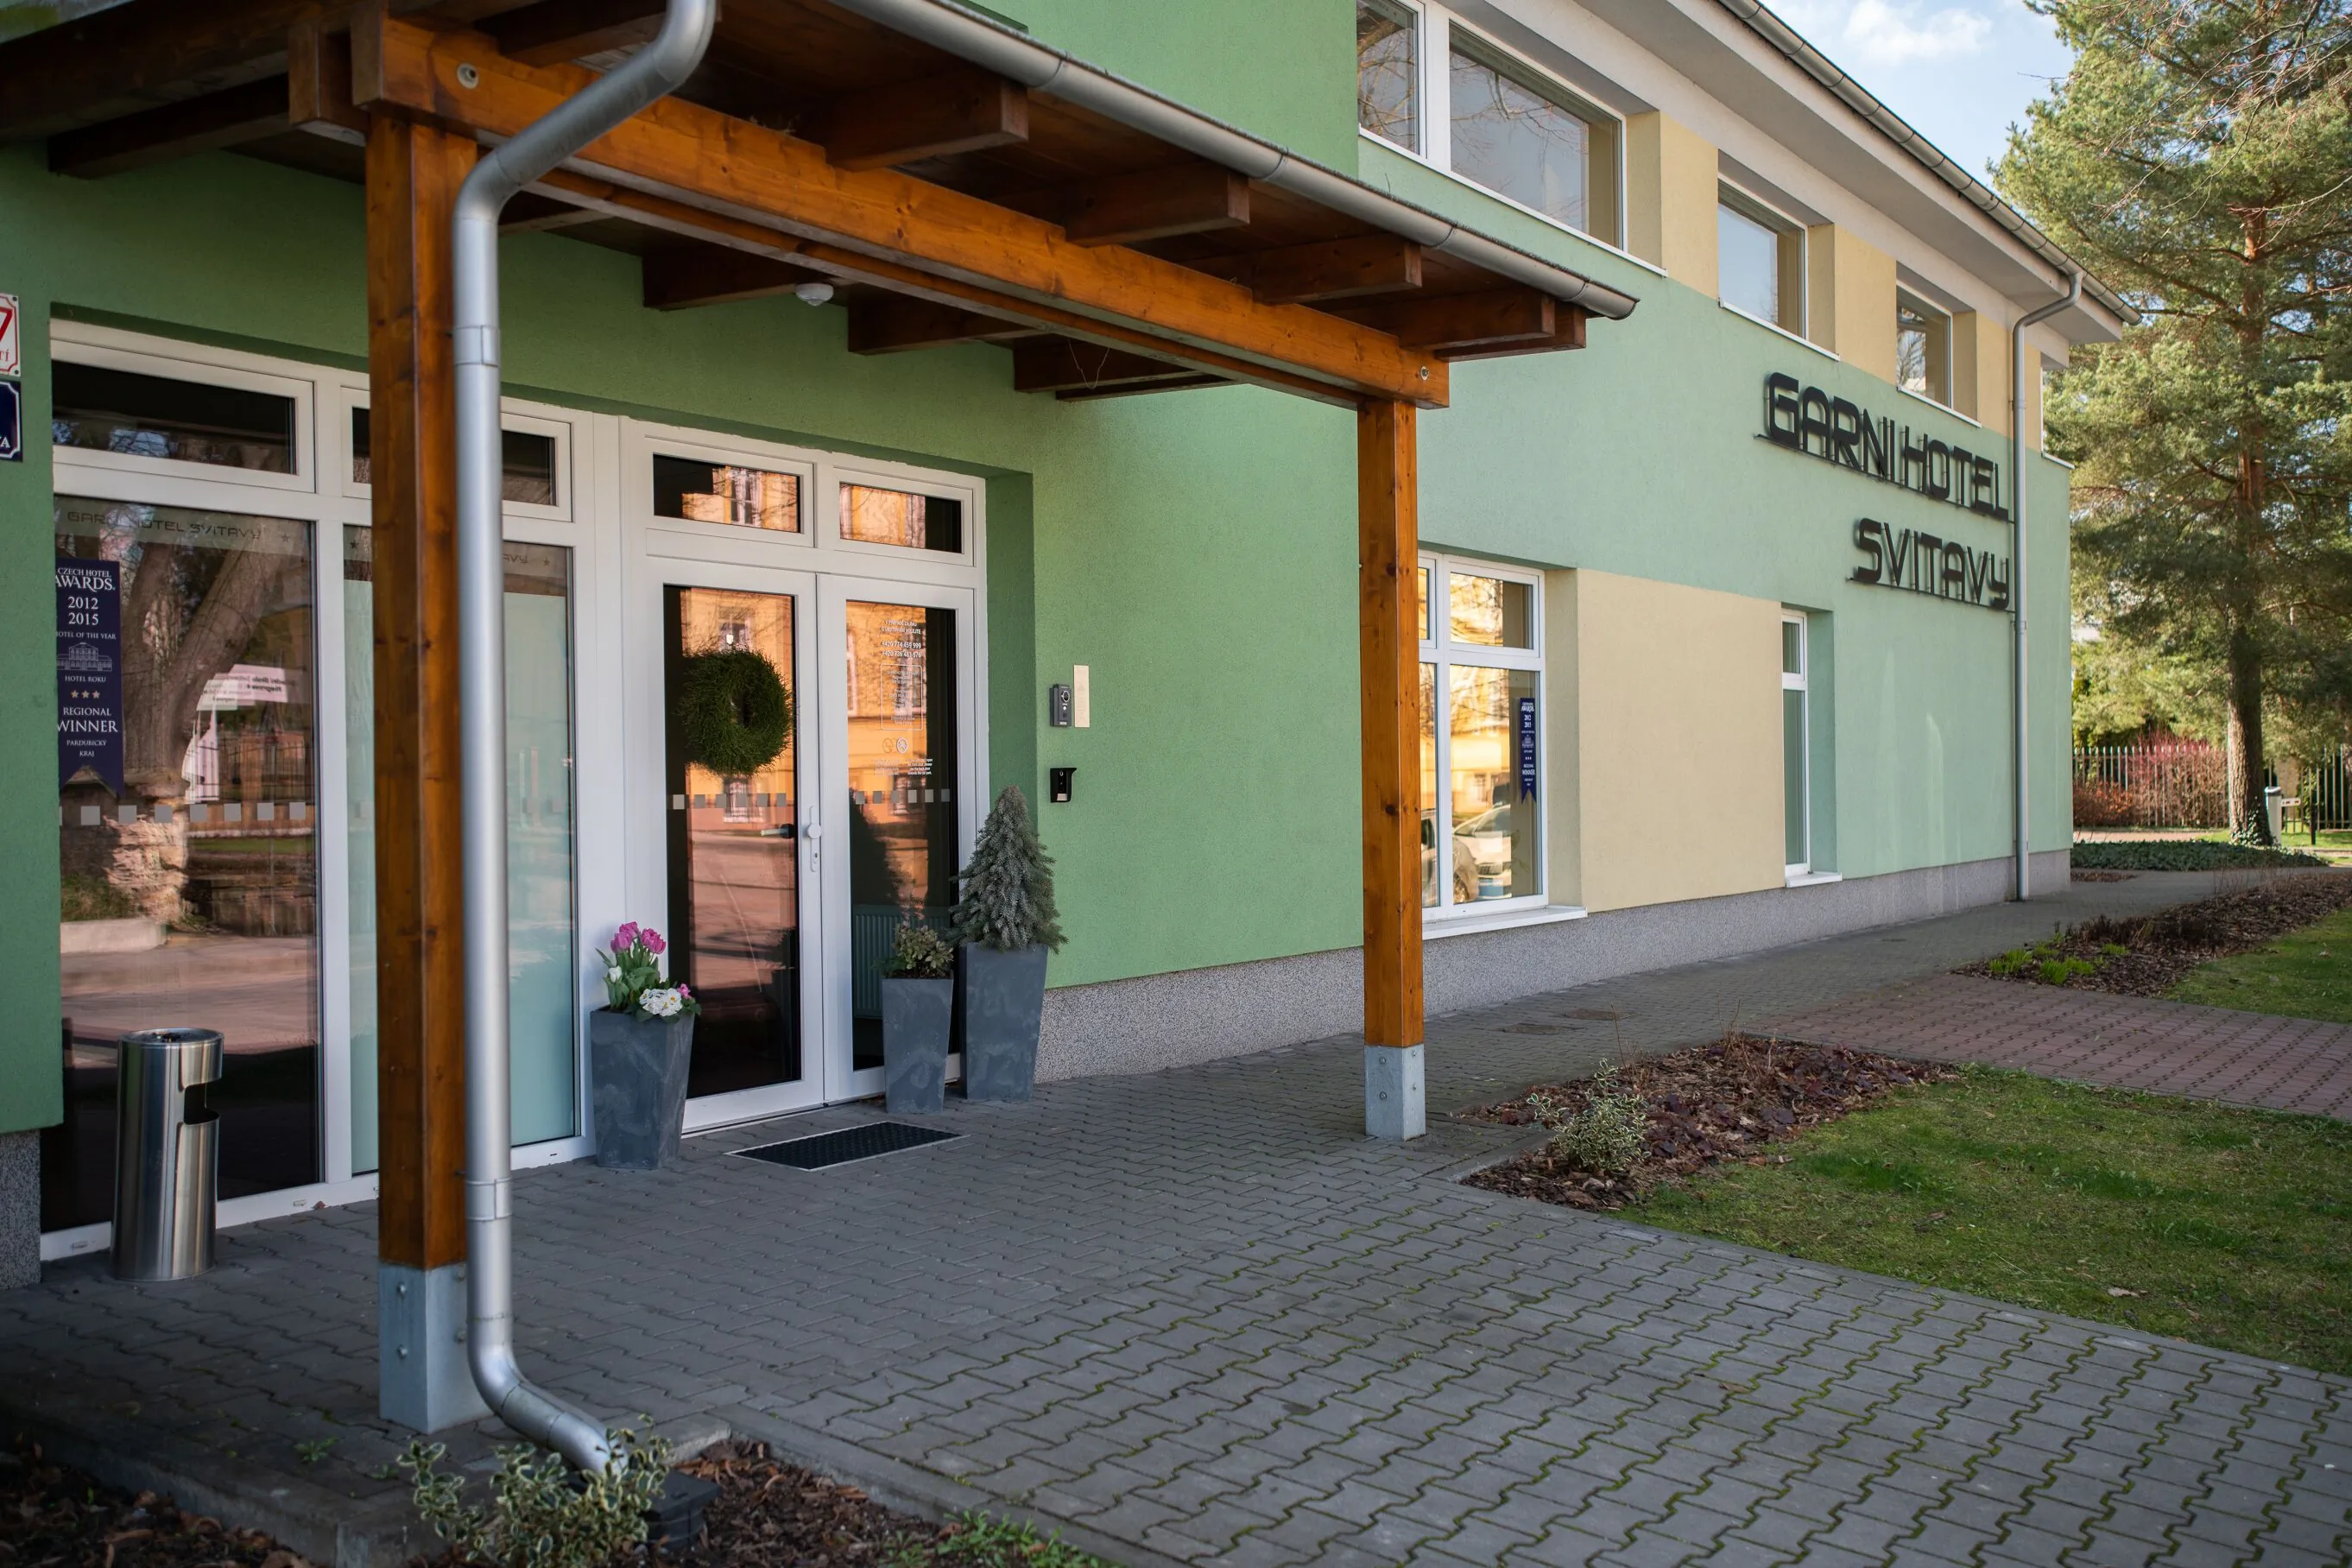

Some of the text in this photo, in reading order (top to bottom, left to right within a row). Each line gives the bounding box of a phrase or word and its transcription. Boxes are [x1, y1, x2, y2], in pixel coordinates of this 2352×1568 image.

[1767, 372, 2009, 521] GARNI HOTEL
[1856, 517, 2009, 610] SVITAVY
[58, 567, 112, 578] CZECH HOTEL
[68, 596, 99, 610] 2012
[68, 612, 99, 626] 2015
[63, 707, 112, 717] REGIONAL
[57, 719, 119, 733] WINNER
[79, 749, 95, 758] KRAJ
